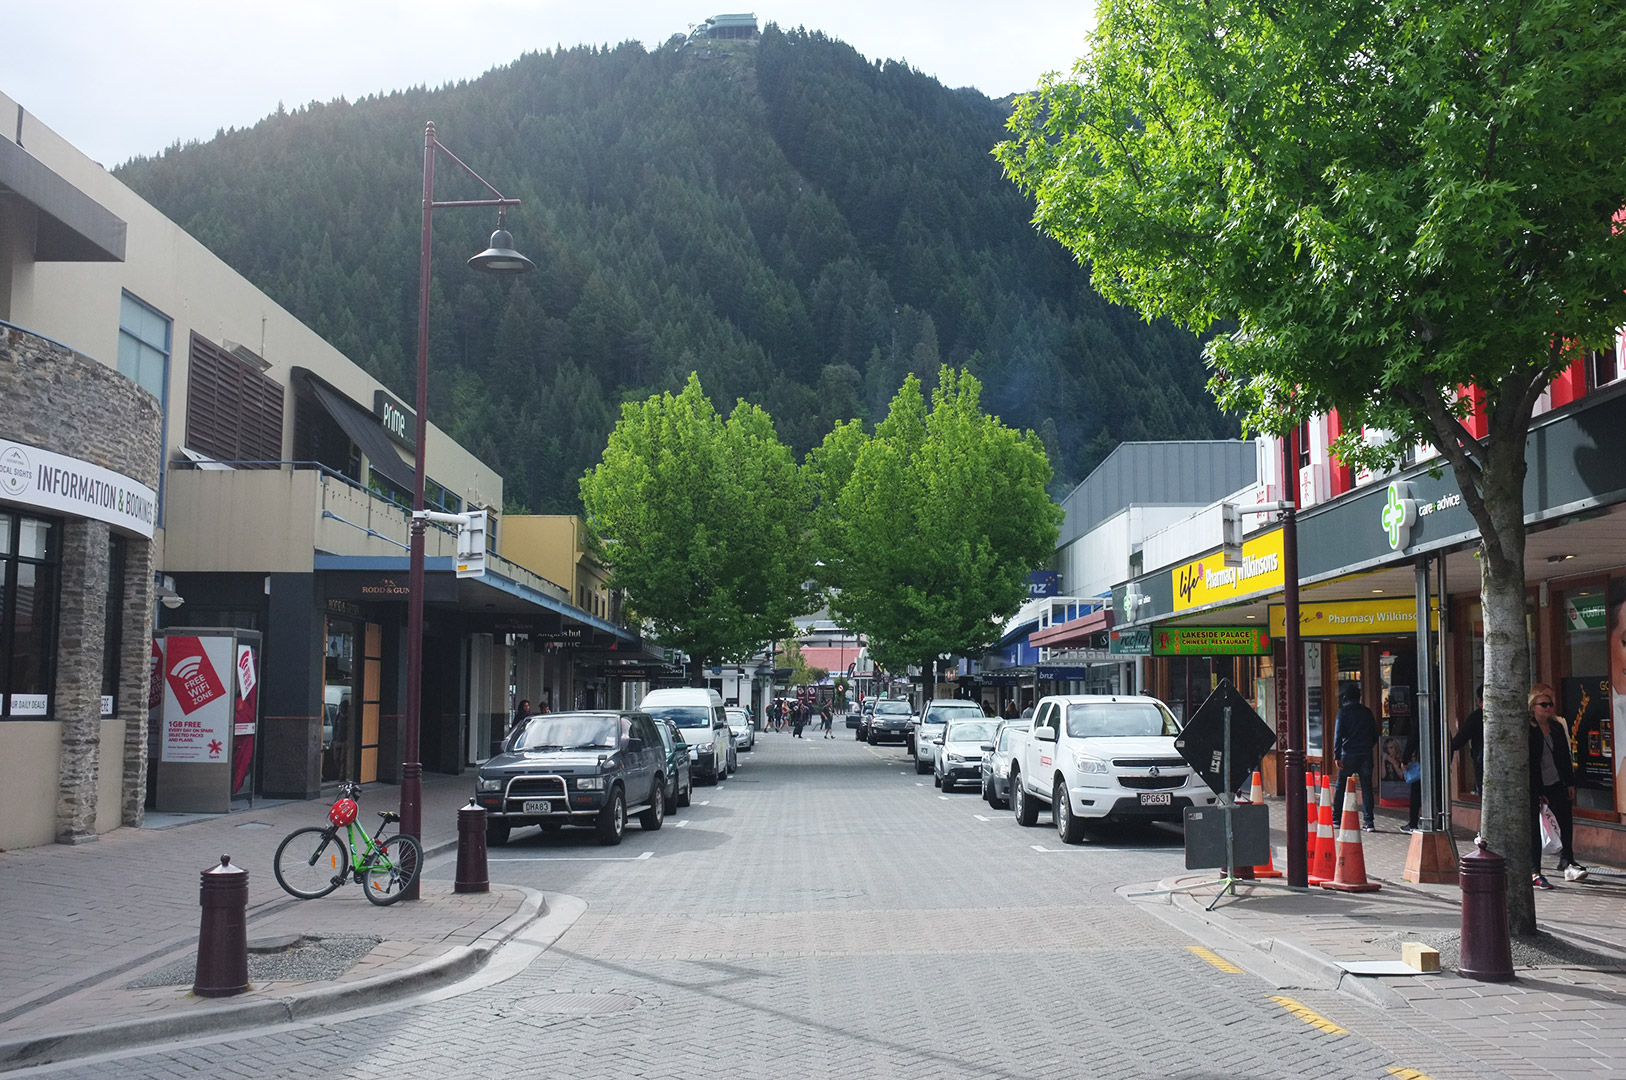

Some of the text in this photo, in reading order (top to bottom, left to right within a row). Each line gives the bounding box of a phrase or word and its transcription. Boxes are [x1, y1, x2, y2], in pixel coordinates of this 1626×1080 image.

[383, 402, 405, 438] prime
[0, 464, 32, 480] OCAL SIGHTS
[37, 463, 153, 525] INFORMATION & BOOKINGS
[1179, 552, 1278, 603] life Pharmacy Wilkinsons
[1023, 582, 1047, 594] nz
[1328, 614, 1375, 624] Pharmacy
[1376, 612, 1418, 622] Wilkinso
[184, 674, 206, 690] FREE
[1039, 670, 1054, 679] bnz
[187, 681, 210, 698] WiFi
[18, 700, 31, 709] DAILY
[31, 700, 45, 709] DEALS
[192, 690, 214, 706] ZONE
[526, 802, 548, 811] DHA83
[1141, 795, 1169, 803] GPG631
